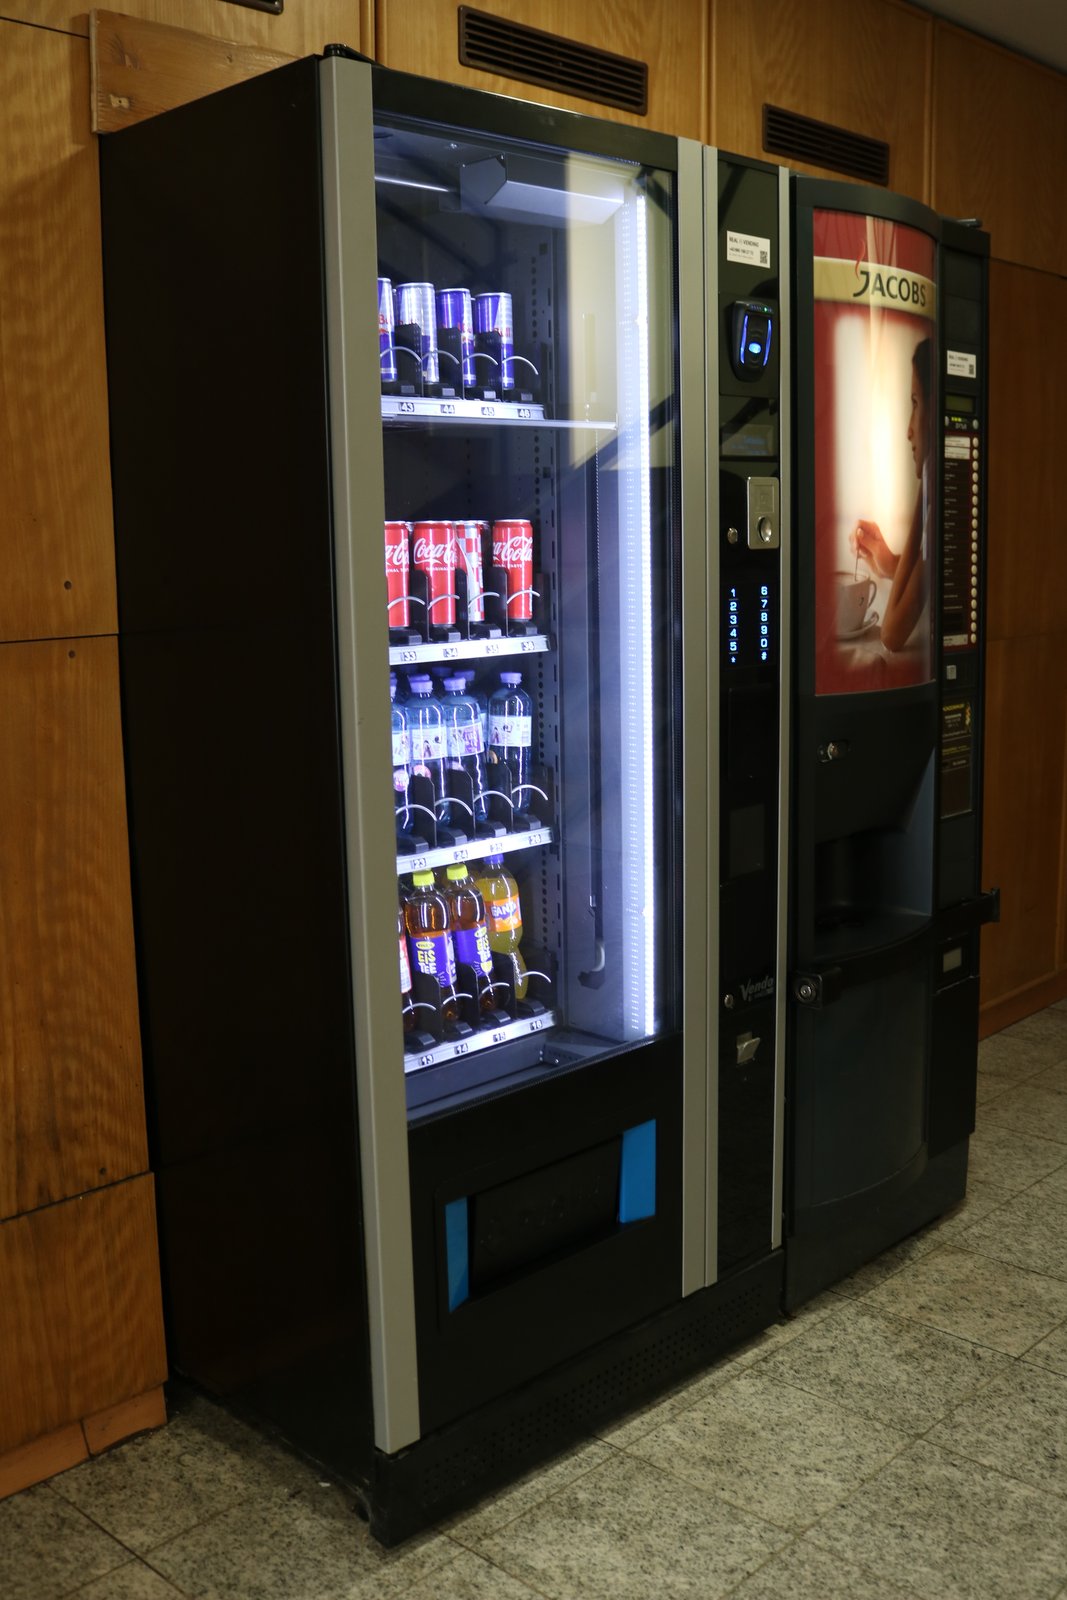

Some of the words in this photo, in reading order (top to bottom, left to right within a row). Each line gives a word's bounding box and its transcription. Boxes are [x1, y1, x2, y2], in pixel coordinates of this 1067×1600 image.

[853, 270, 926, 307] JACOBS
[400, 402, 414, 412] 43
[441, 404, 455, 414] 44
[731, 588, 736, 598] 1
[761, 585, 768, 596] 6
[730, 601, 738, 611] 2
[761, 599, 768, 609] 7
[730, 615, 738, 625] 3
[761, 612, 768, 622] 8
[730, 628, 737, 638] 4
[761, 625, 768, 635] 9
[730, 641, 738, 651] 5
[761, 638, 768, 648] 0
[740, 975, 774, 1001] Vendo
[420, 1054, 434, 1065] 13
[455, 1043, 468, 1054] 14
